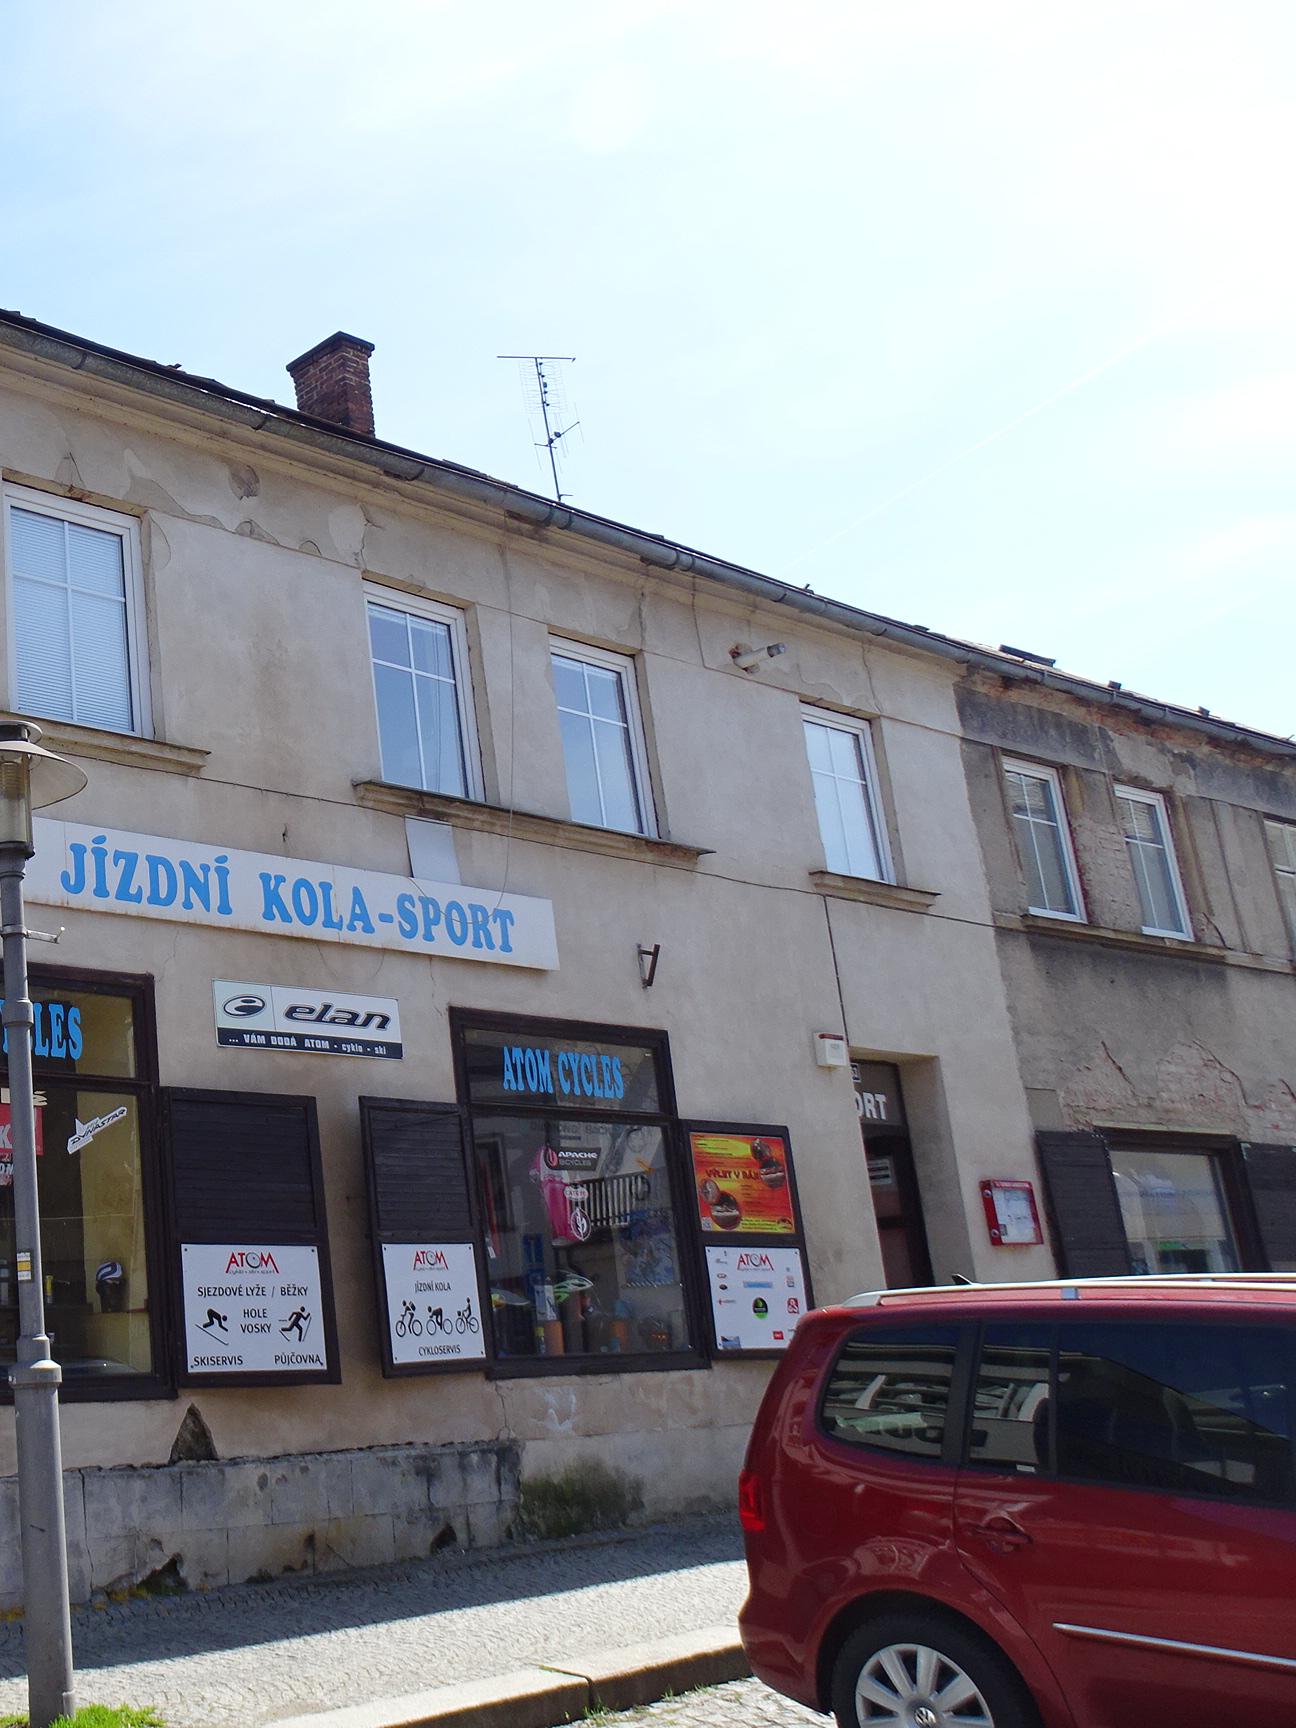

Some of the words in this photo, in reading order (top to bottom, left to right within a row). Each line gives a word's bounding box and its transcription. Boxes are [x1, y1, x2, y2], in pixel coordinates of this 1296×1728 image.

[60, 834, 234, 916] JÍZDNÍ
[258, 871, 515, 953] KOLA-SPORT
[284, 1001, 393, 1031] elan
[243, 1033, 266, 1045] VÁM
[304, 1037, 330, 1050] ATOM
[341, 1042, 363, 1054] cyklo
[503, 1046, 554, 1094] ATOM
[557, 1051, 625, 1100] CYCLES
[558, 1151, 599, 1159] APACHE
[225, 1251, 280, 1274] ATOM
[413, 1250, 449, 1271] ATOM
[737, 1253, 775, 1271] ATOM
[197, 1284, 244, 1299] SJEZDOVÉ
[245, 1283, 267, 1297] LYŽE
[280, 1283, 309, 1297] BĚŽKY
[414, 1280, 434, 1294] JÍZDNÍ
[434, 1281, 452, 1292] KOLA
[243, 1308, 268, 1319] HOLE
[240, 1323, 272, 1334] VOSKY
[418, 1344, 462, 1357] CYKLOSERVIS
[193, 1355, 244, 1367] SKISERVIS
[274, 1352, 322, 1366] PŮJČOVNA
